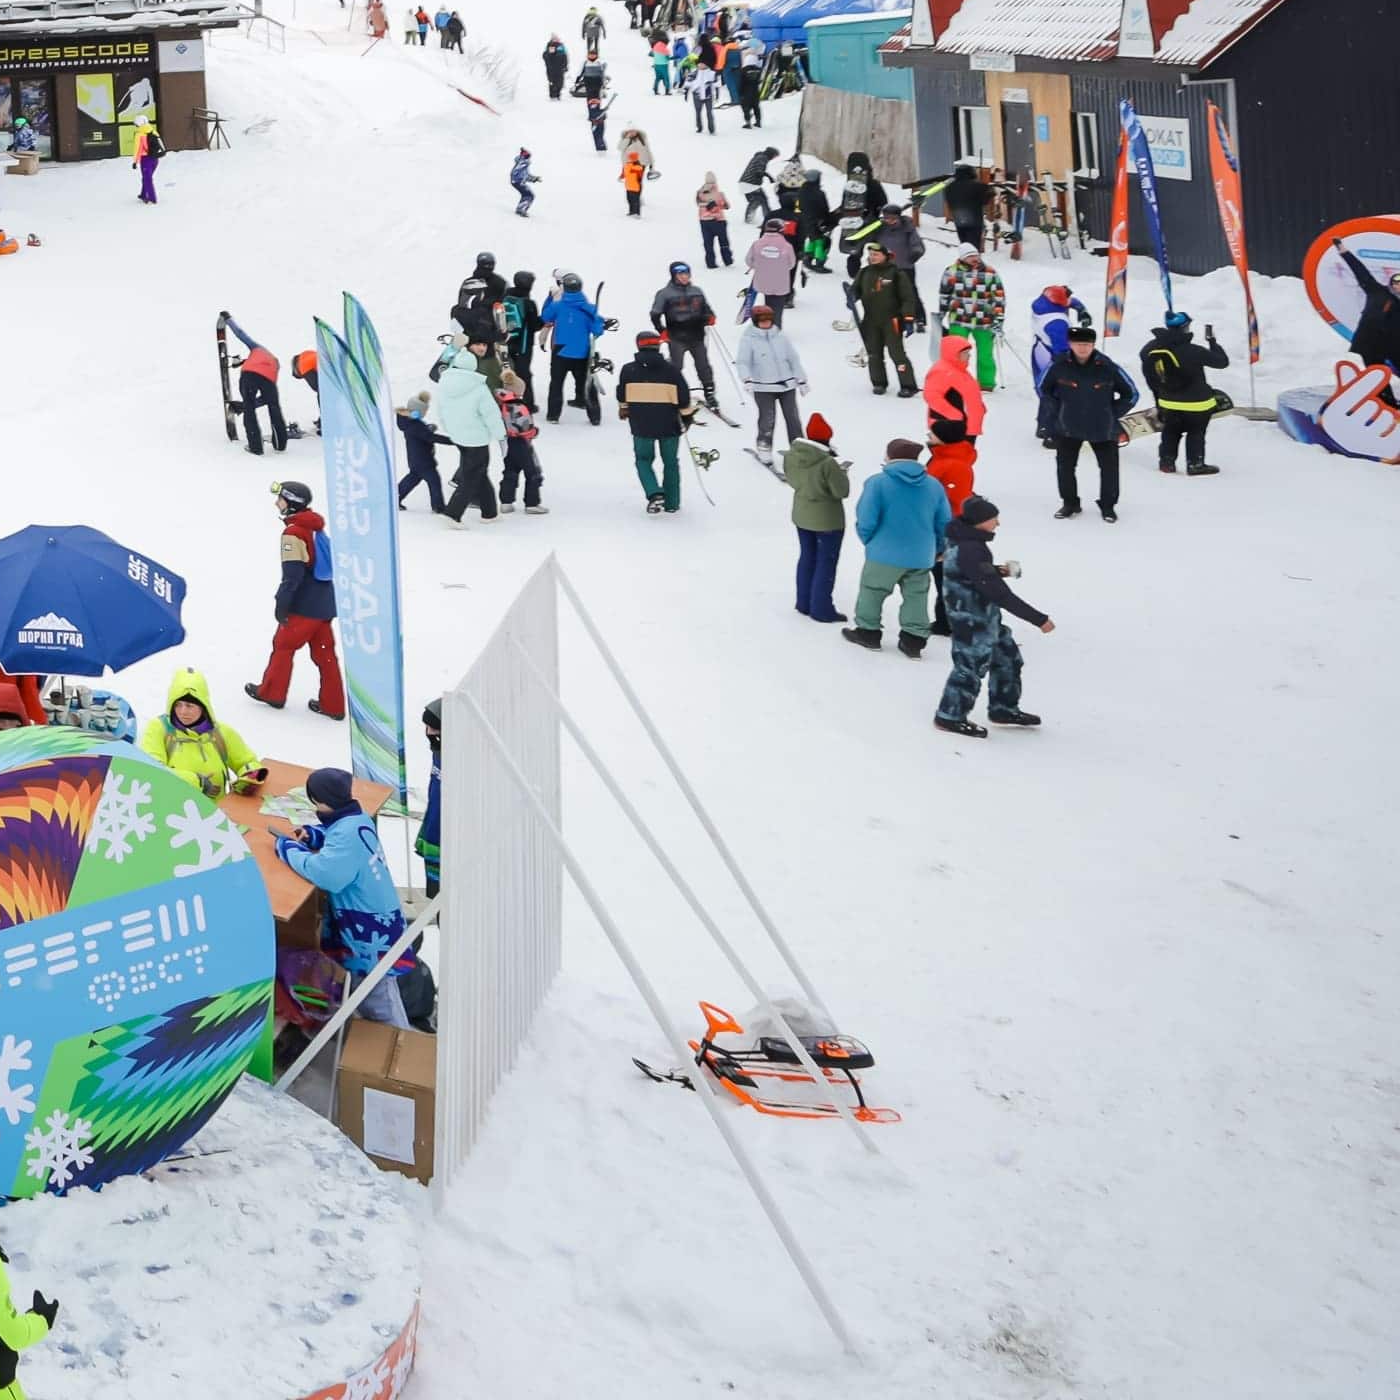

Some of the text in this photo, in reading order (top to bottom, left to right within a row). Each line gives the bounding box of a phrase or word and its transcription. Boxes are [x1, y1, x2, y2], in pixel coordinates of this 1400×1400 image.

[1148, 129, 1184, 147] ОКАТ
[18, 630, 85, 649] ШОРИЯ ГРАД
[88, 943, 209, 1012] ФЕСТ
